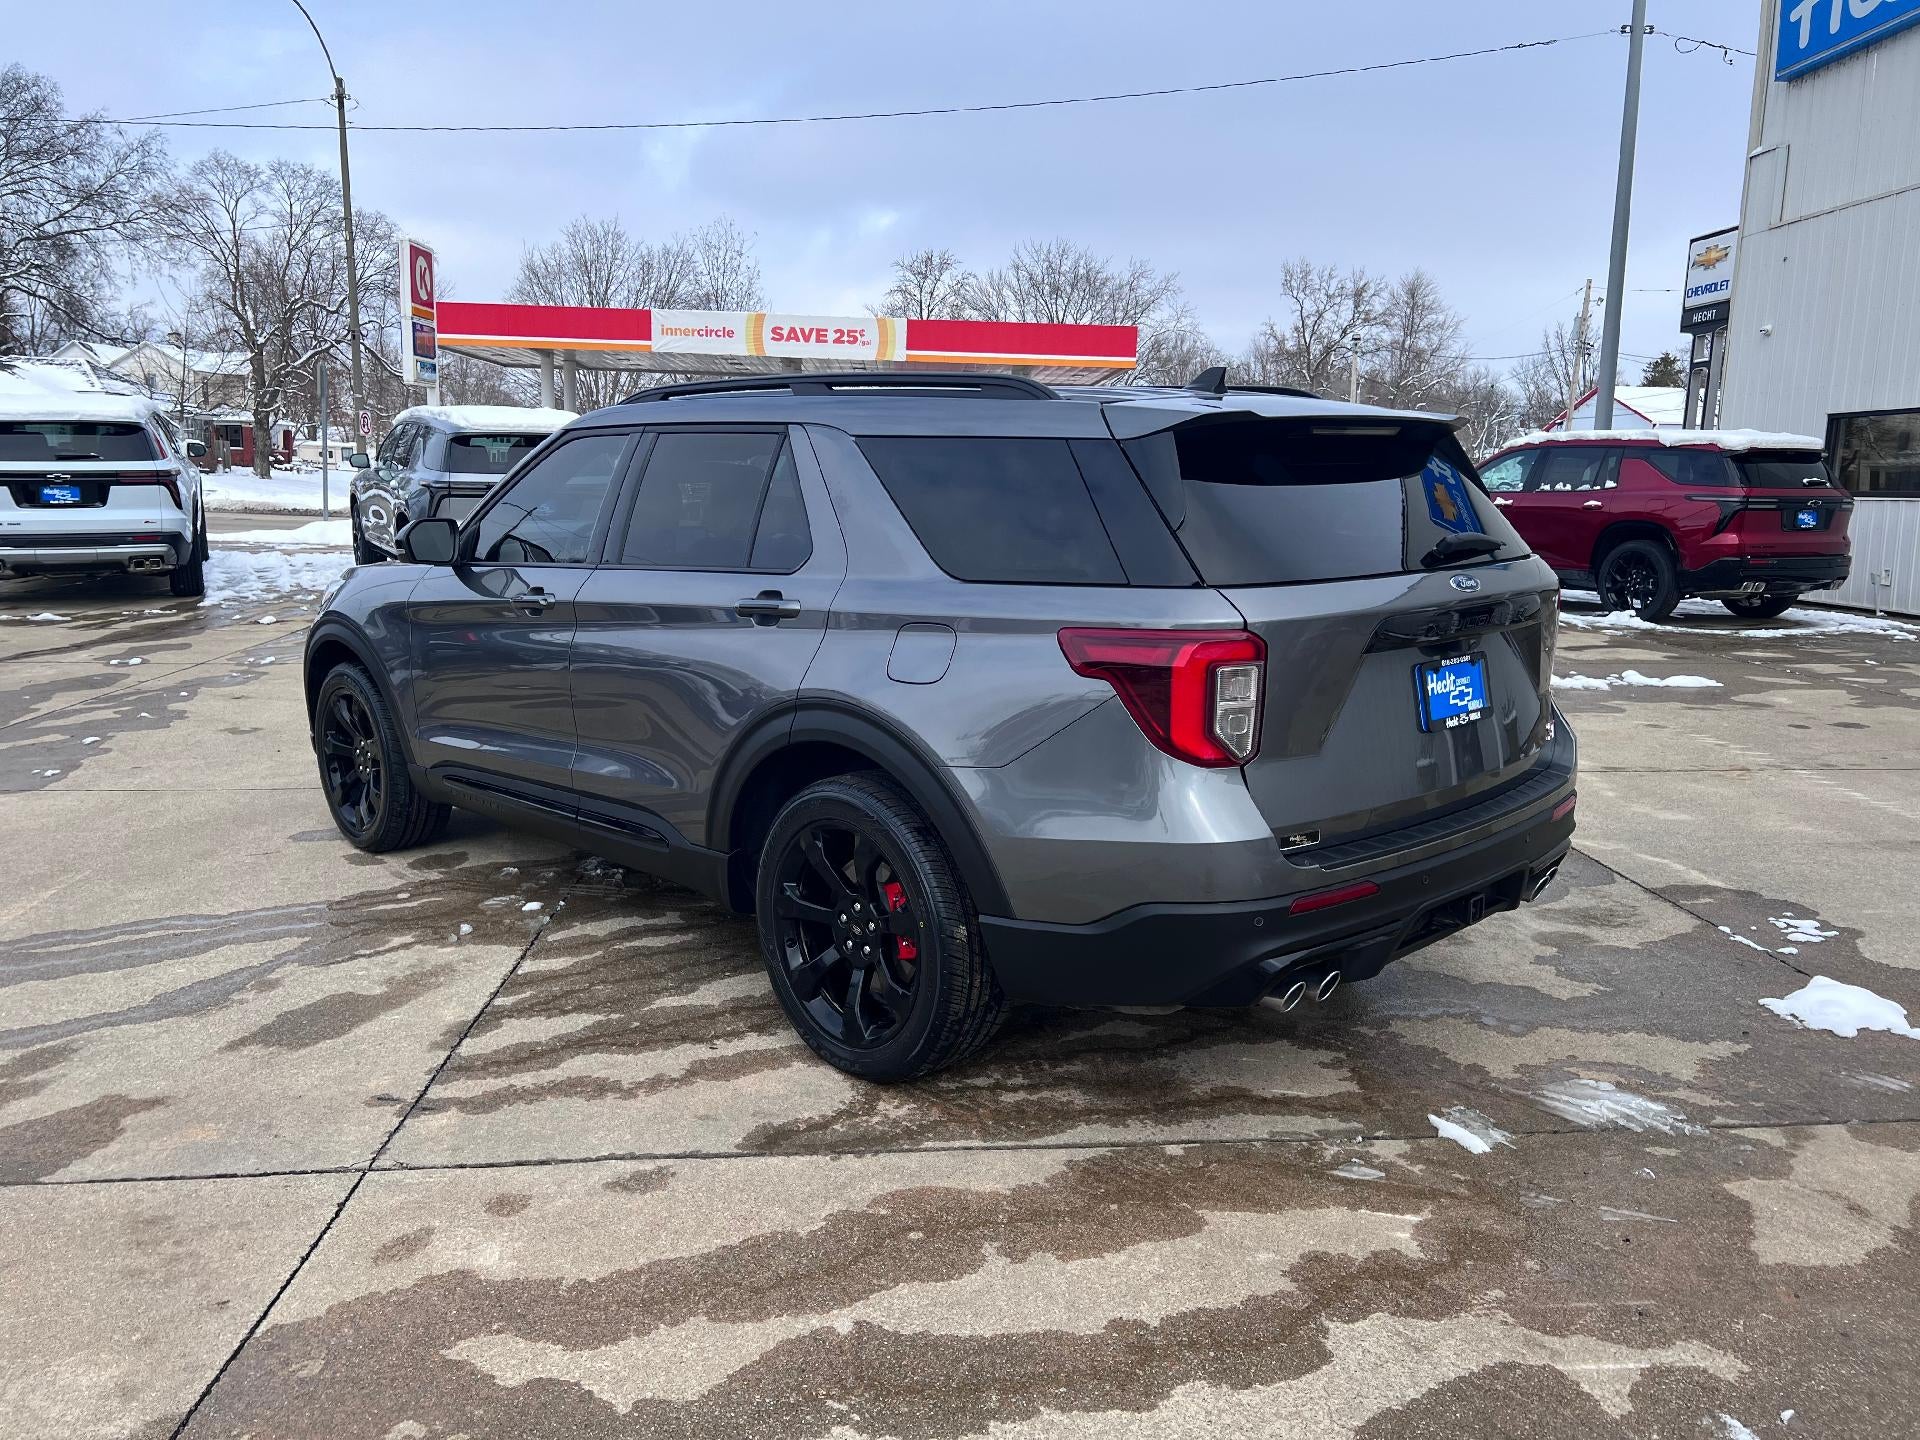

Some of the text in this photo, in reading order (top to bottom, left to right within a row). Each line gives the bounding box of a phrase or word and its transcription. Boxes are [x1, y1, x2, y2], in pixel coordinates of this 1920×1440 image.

[420, 264, 430, 298] K
[1687, 280, 1730, 298] CHEVROLET
[1693, 310, 1716, 322] HECHT
[661, 325, 734, 338] innercircle
[771, 326, 828, 344] SAVE
[1427, 671, 1456, 696] Hecht
